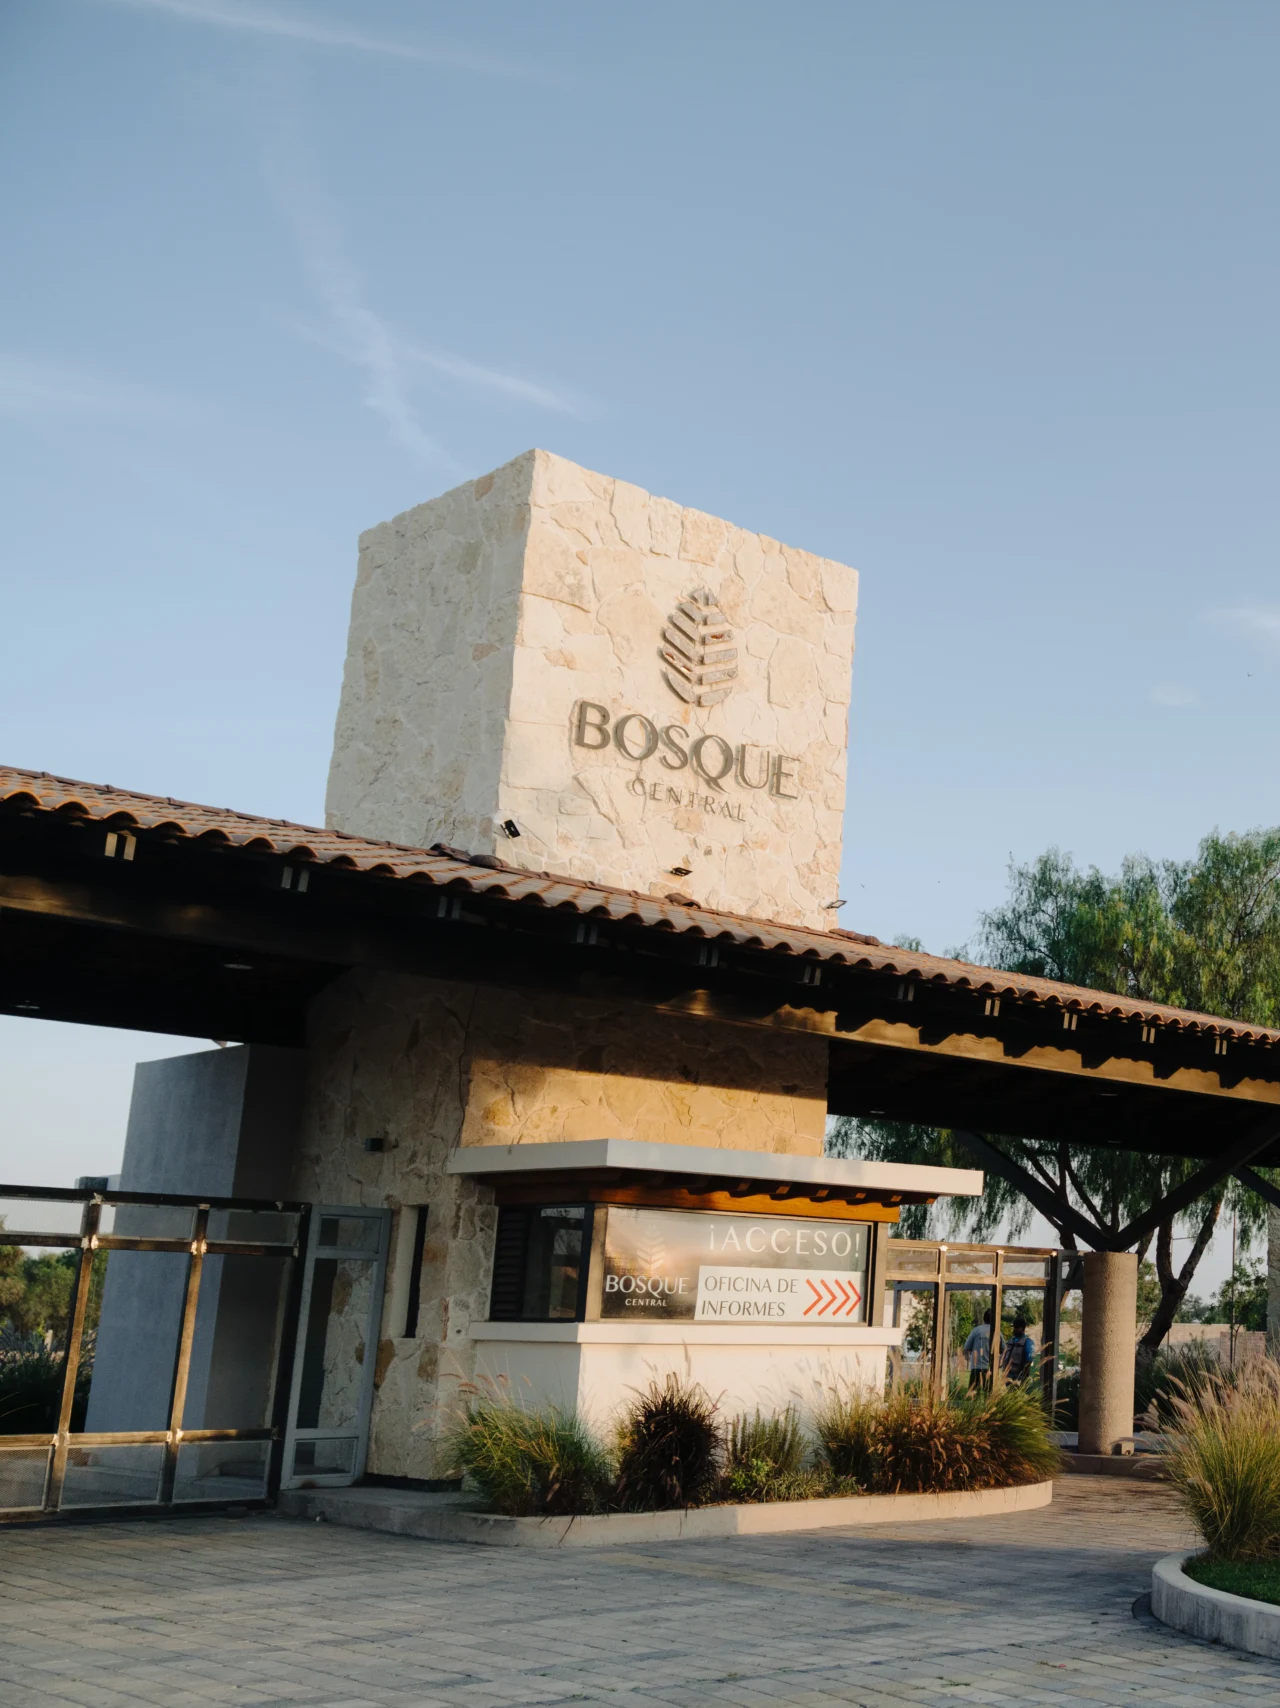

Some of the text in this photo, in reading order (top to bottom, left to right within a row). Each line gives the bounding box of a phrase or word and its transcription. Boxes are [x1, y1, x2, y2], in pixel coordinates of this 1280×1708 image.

[575, 700, 800, 799] BOSQUE
[629, 778, 747, 823] CENTRAL
[709, 1224, 860, 1258] ¡ACCESO!
[605, 1274, 690, 1298] BOSQUE
[704, 1275, 799, 1294] OFICINA DE
[624, 1298, 667, 1307] CENTRAL
[701, 1300, 786, 1317] INFORMES
